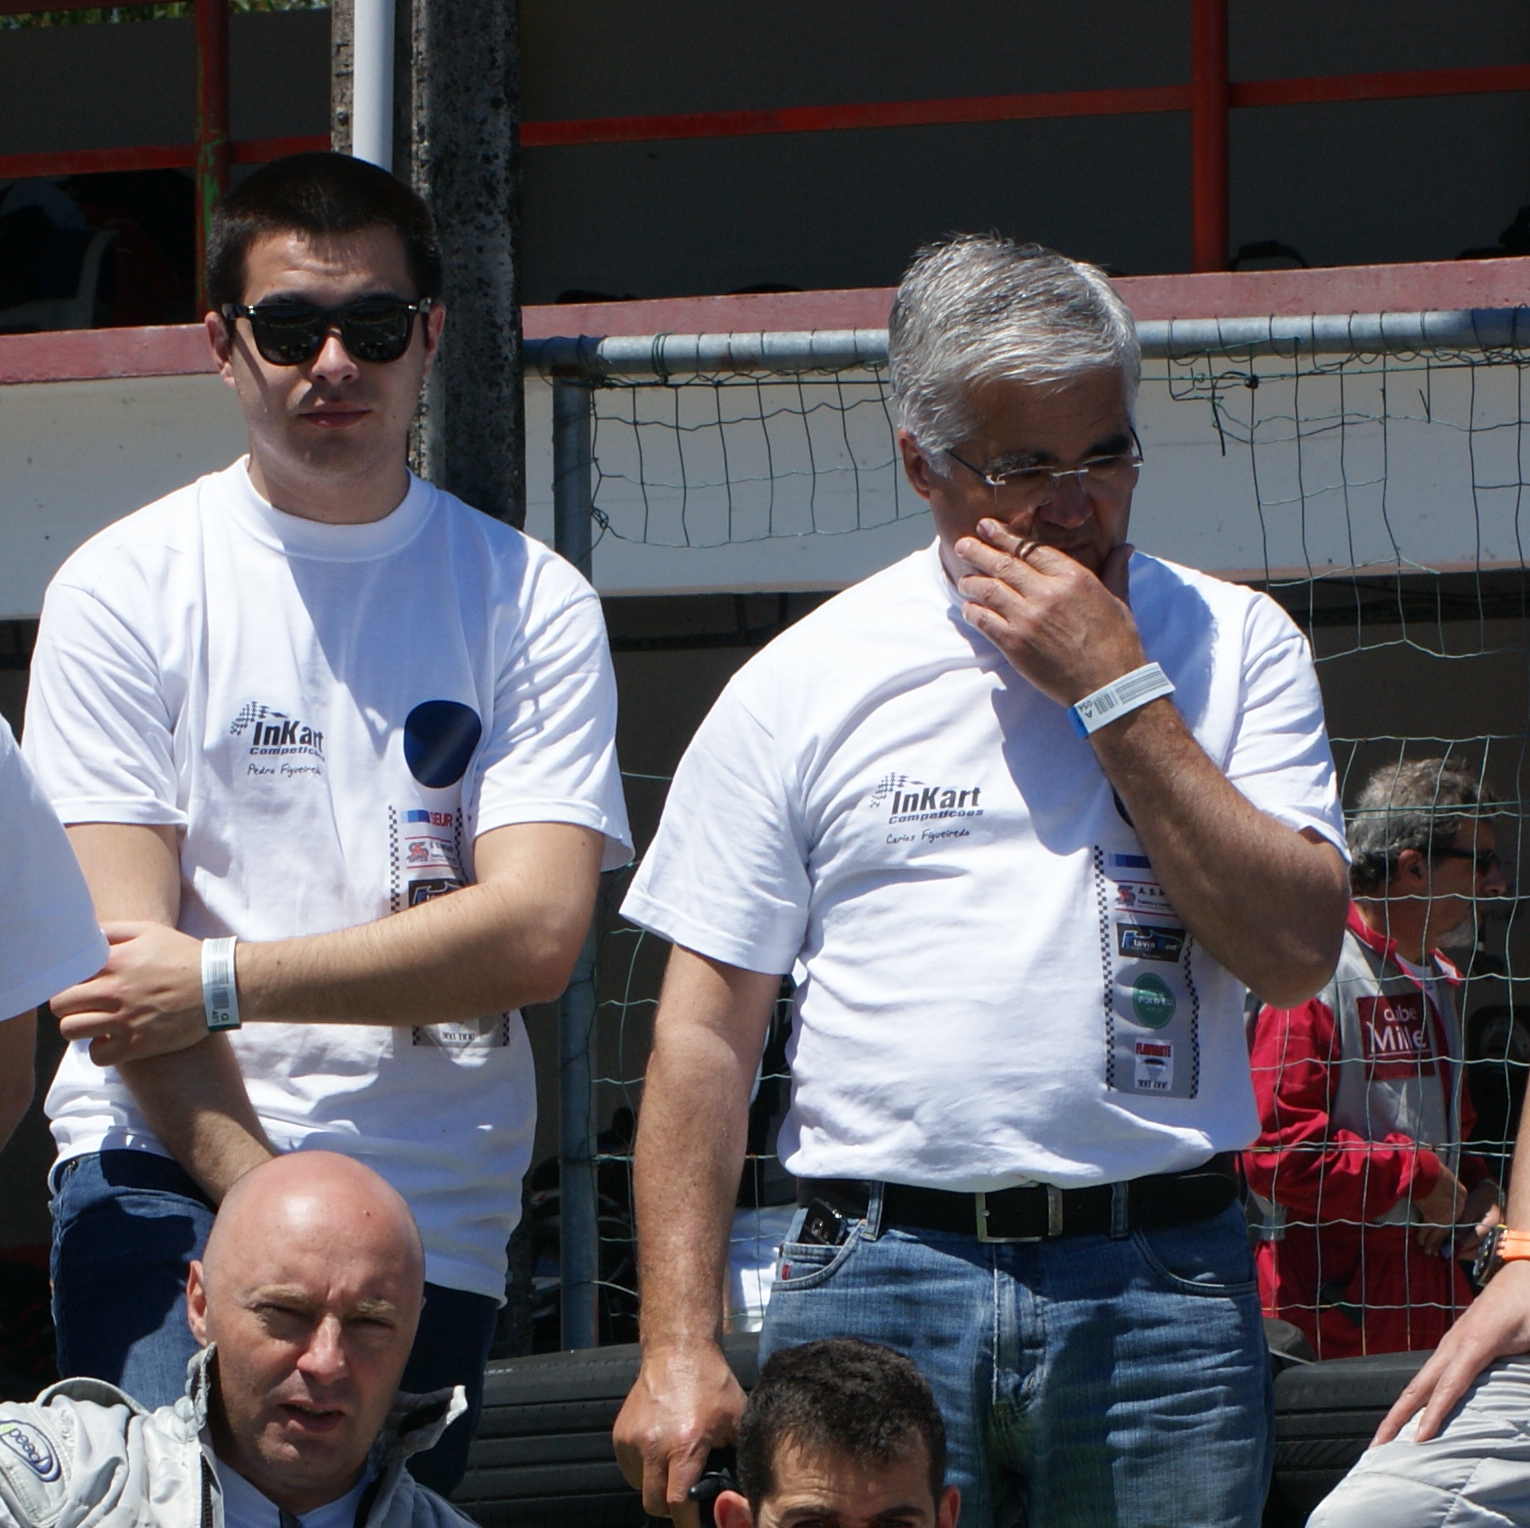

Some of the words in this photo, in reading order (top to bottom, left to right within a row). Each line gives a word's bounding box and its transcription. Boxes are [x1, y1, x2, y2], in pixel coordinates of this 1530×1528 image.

[253, 720, 324, 753] InKart
[892, 786, 981, 815] InKart
[1366, 1021, 1427, 1053] Mille
